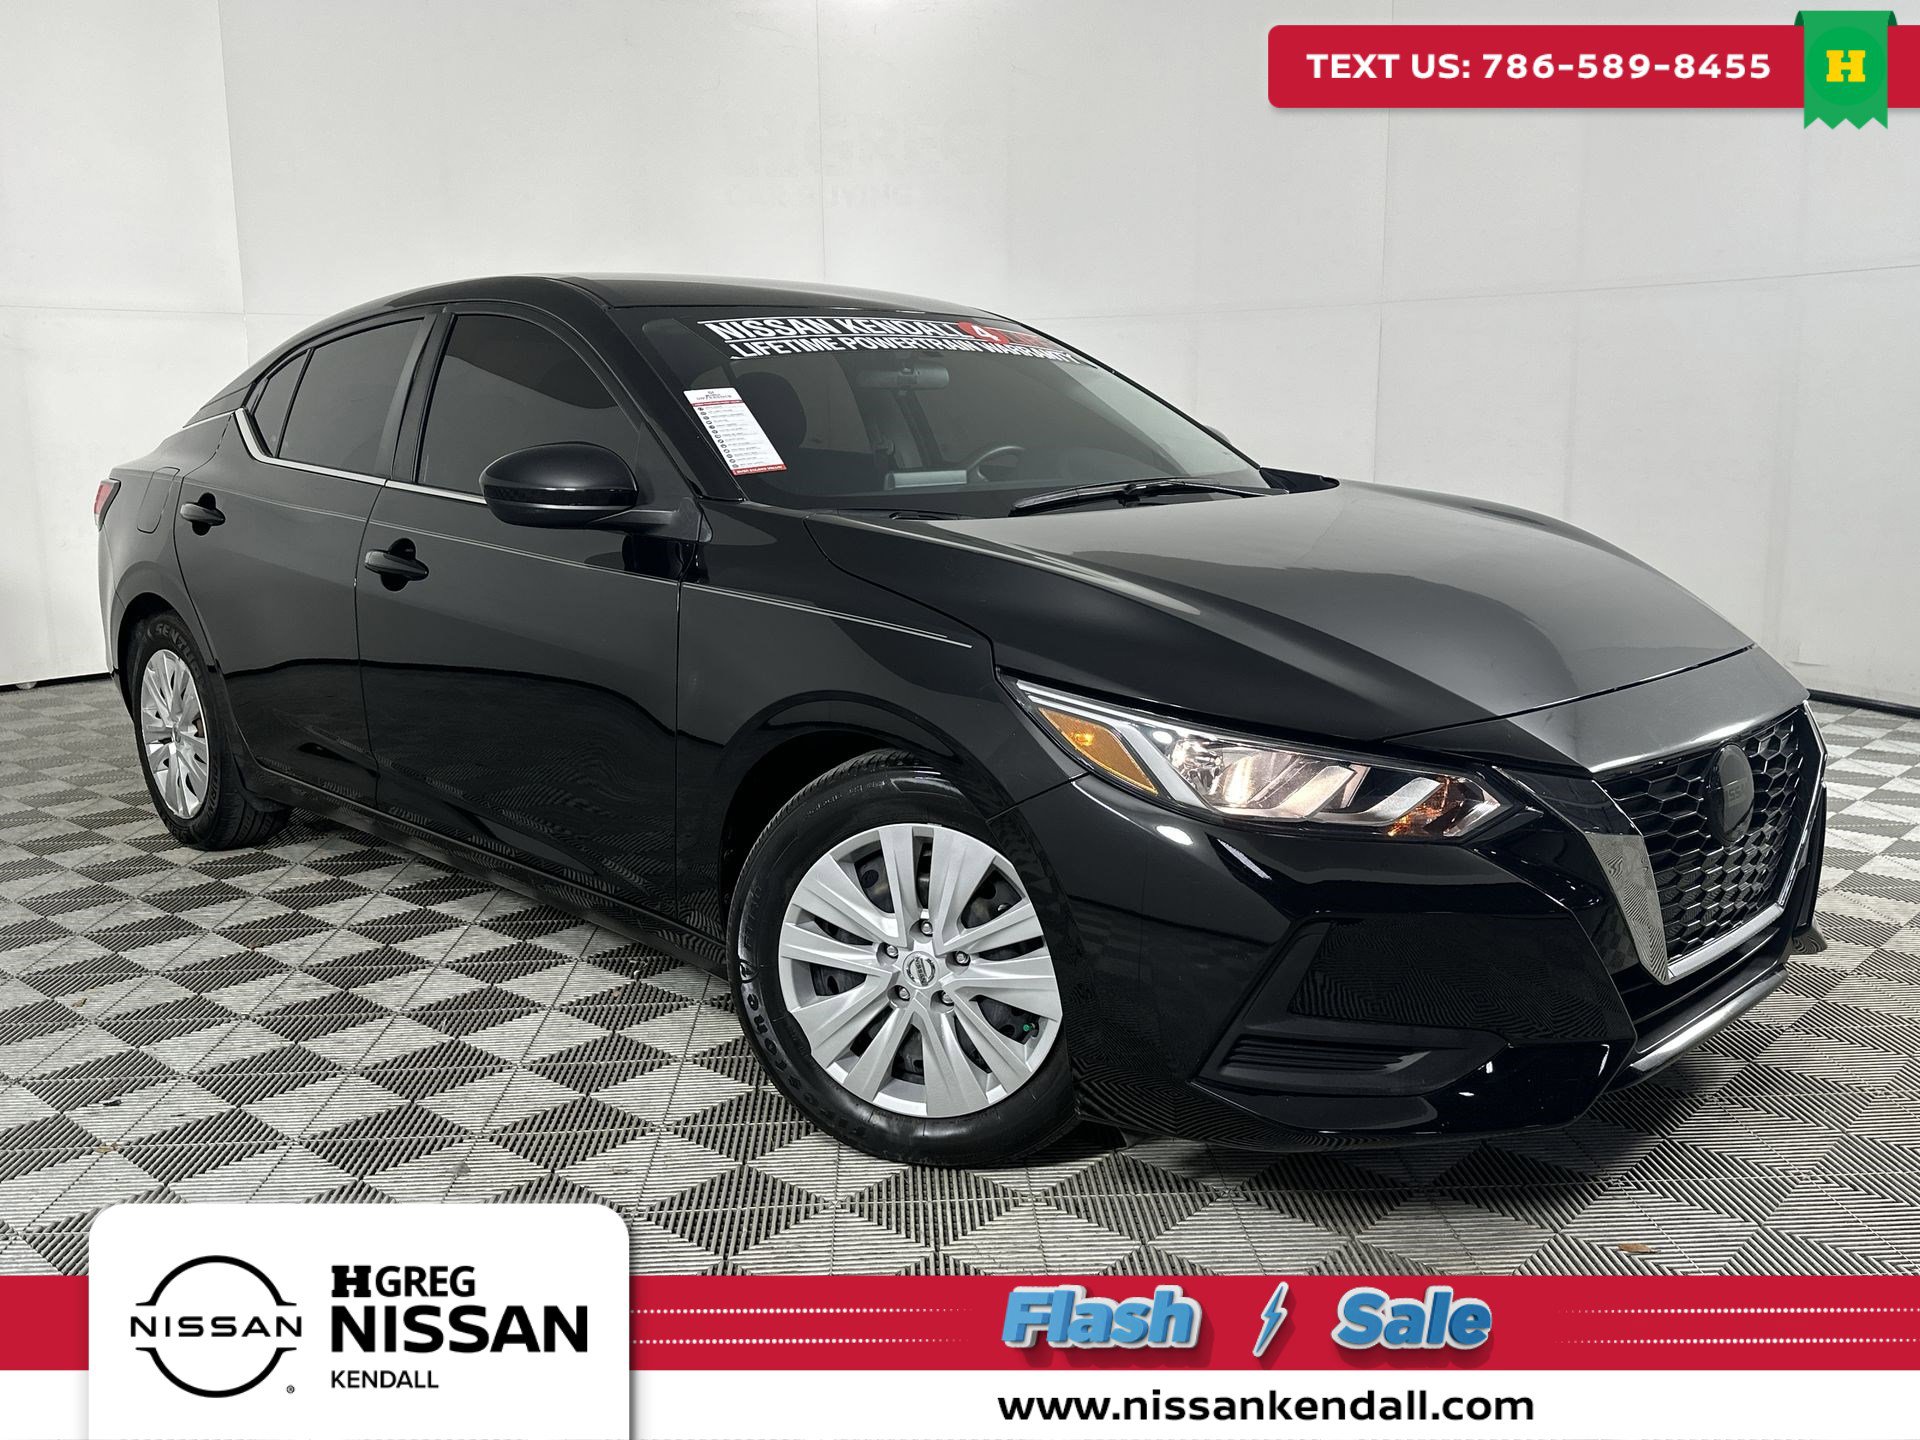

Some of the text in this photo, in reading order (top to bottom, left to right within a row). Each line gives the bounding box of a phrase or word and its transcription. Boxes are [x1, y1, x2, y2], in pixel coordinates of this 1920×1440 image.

[704, 318, 842, 340] NISSAN
[833, 317, 975, 339] KENDALL
[971, 325, 1001, 341] 4
[729, 337, 1081, 365] LIFETIME POWERTRAIN WARRANTY
